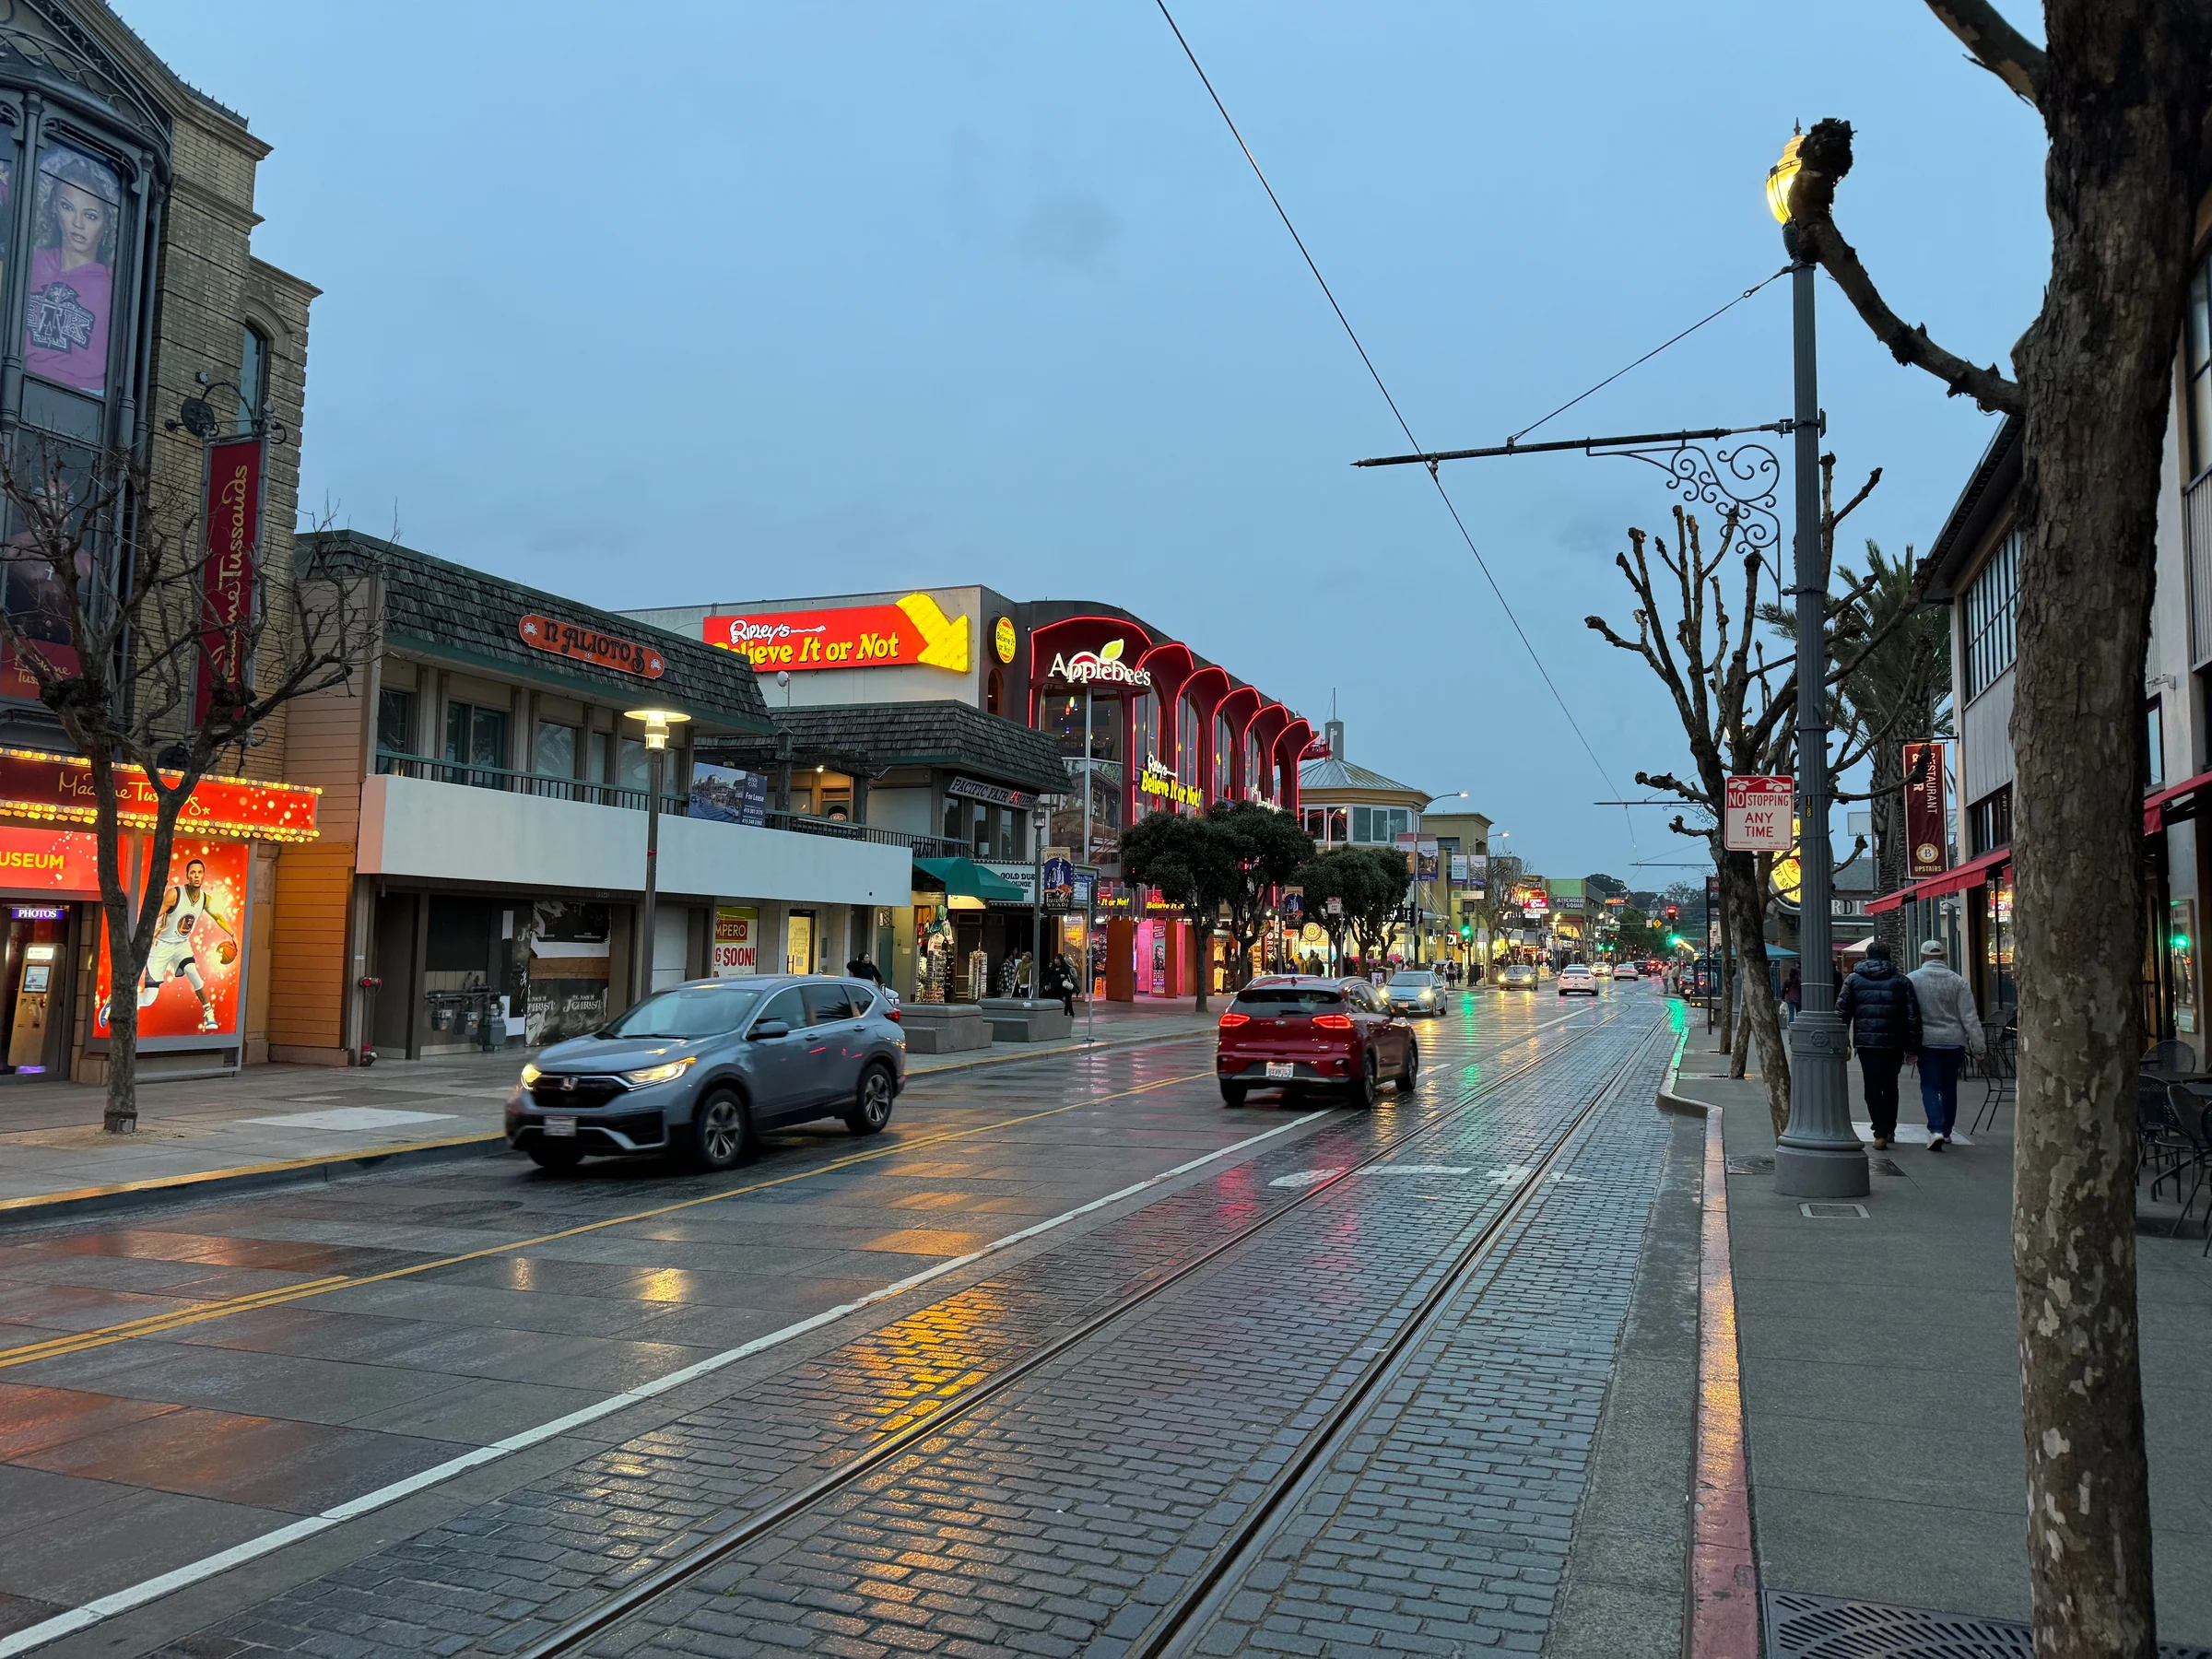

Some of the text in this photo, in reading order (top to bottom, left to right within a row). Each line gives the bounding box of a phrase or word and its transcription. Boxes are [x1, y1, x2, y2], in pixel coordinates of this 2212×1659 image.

[218, 465, 248, 590] Tussauds
[798, 636, 820, 663] It
[826, 641, 853, 662] or
[856, 631, 899, 660] Not
[1048, 652, 1151, 687] Applebee's
[952, 778, 988, 797] PACIFIC
[987, 788, 1008, 804] FAIR
[1141, 771, 1169, 798] Believe
[1178, 788, 1186, 804] or
[1186, 785, 1202, 807] Not!
[753, 794, 765, 802] Lease
[1728, 793, 1789, 807] NO STOPPING
[1745, 812, 1773, 824] ANY
[1745, 826, 1773, 838] TIME
[18, 909, 57, 918] PHOTOS
[1147, 901, 1171, 910] Believe
[723, 947, 756, 967] SOON!
